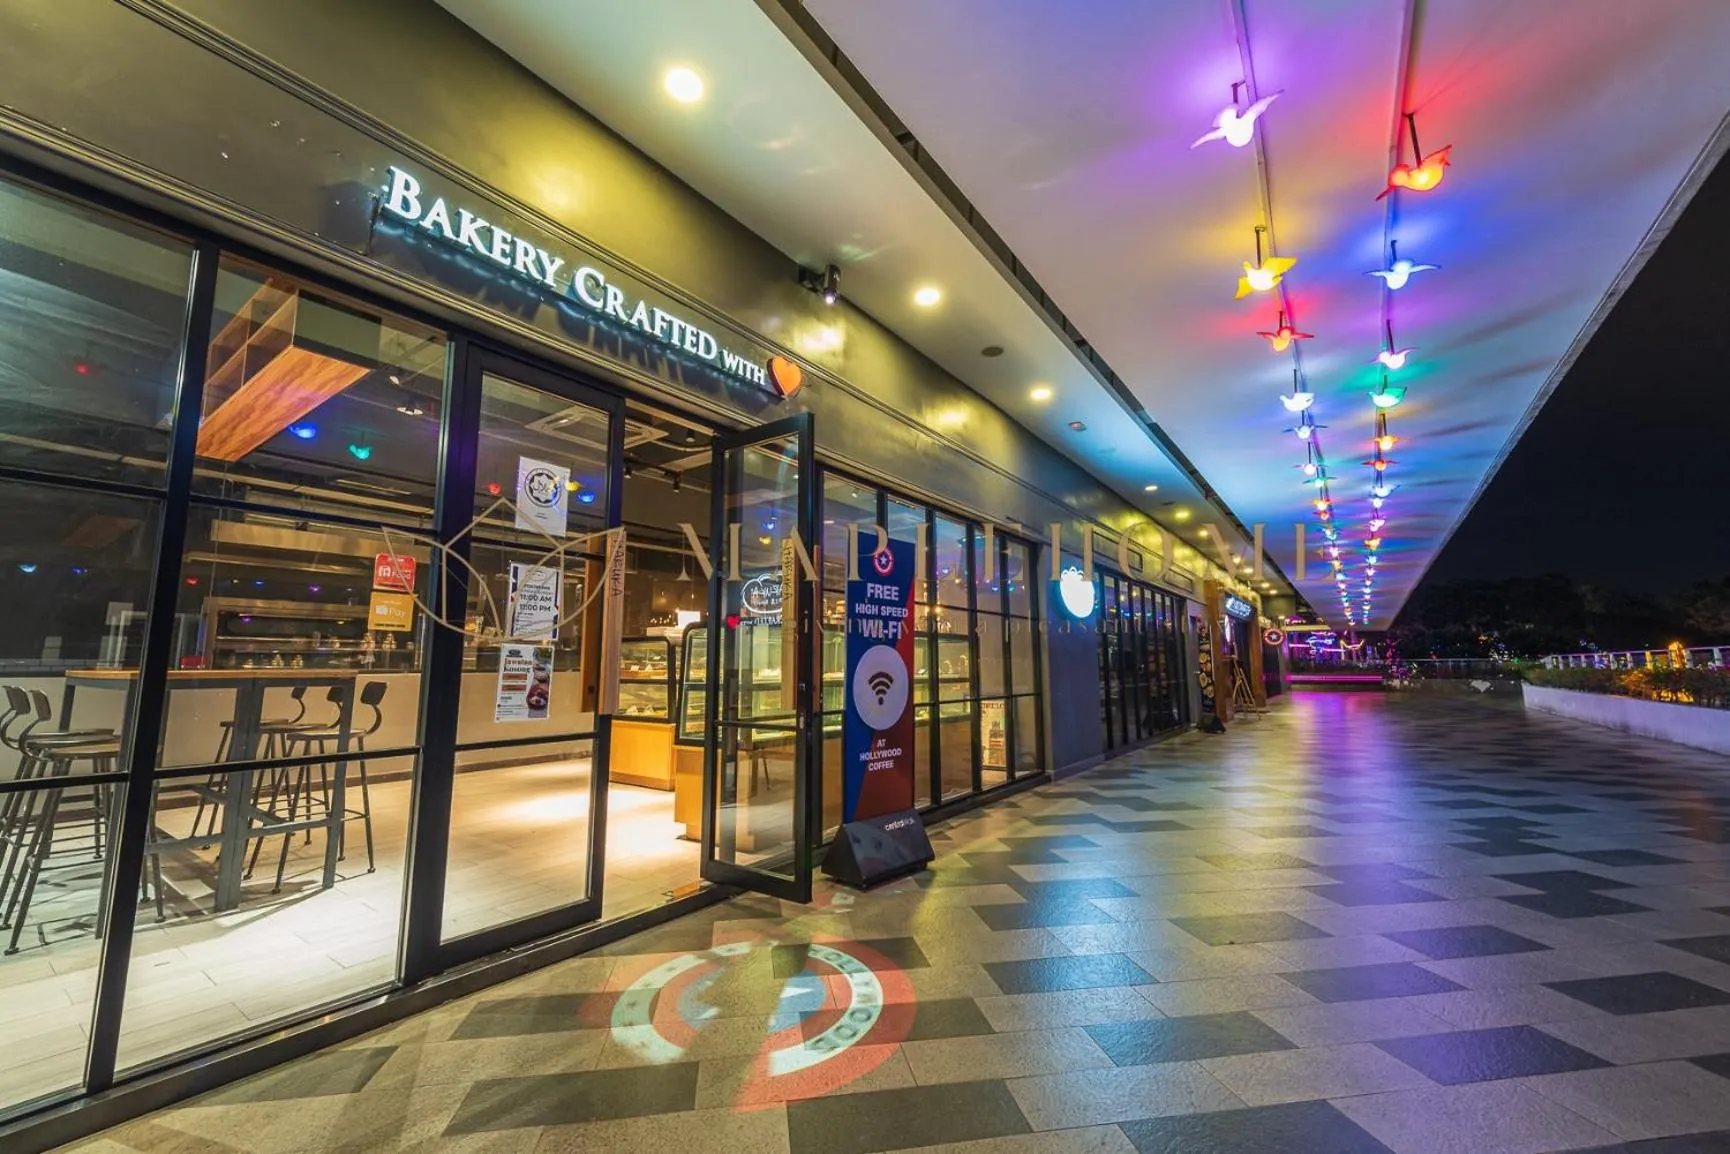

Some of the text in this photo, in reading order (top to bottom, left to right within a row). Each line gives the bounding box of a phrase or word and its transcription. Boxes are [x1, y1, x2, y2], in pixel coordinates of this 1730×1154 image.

[383, 165, 767, 386] BAKERY CRAFTED WITH
[867, 583, 900, 601] FREE
[855, 603, 909, 618] HIGH SPEED
[862, 618, 902, 640] WI-FI
[876, 738, 887, 747] AT
[859, 747, 903, 761] HOLLYWOOD
[867, 760, 895, 772] COFFEE
